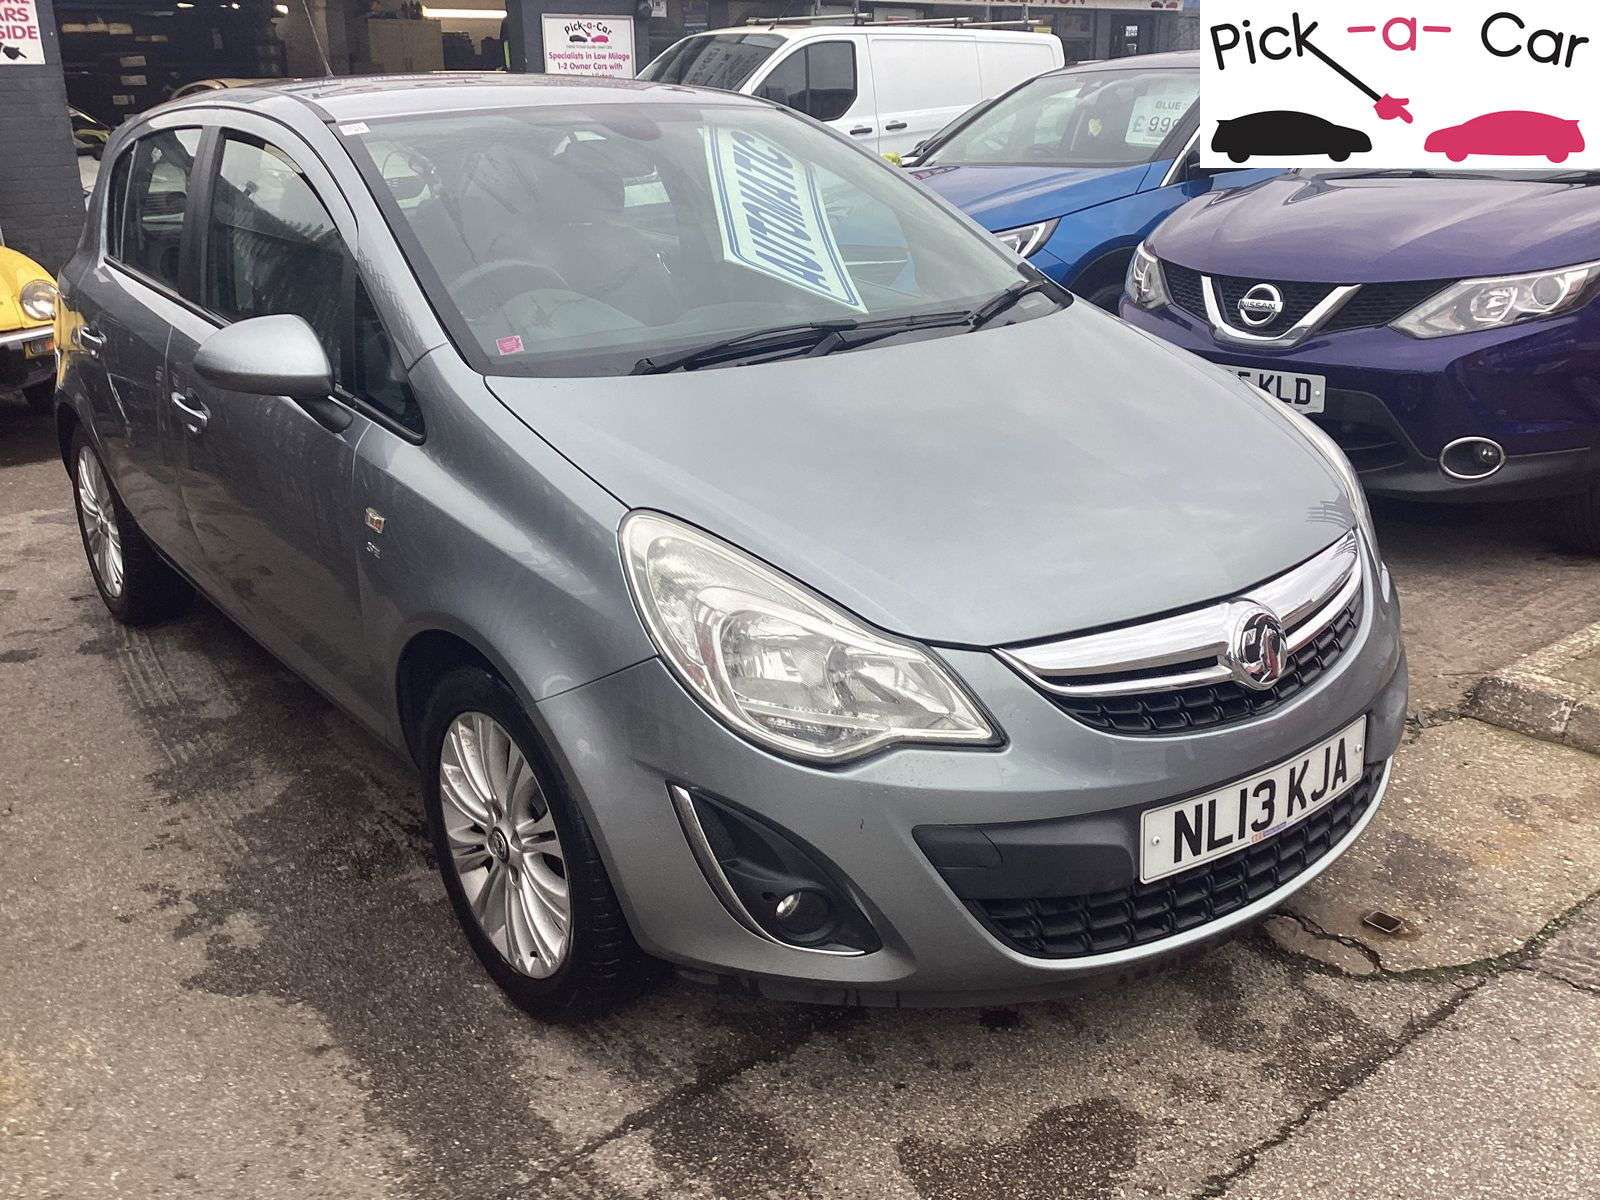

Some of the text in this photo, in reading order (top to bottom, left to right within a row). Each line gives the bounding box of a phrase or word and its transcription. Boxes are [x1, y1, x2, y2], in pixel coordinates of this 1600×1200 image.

[548, 51, 583, 61] Specialists
[585, 51, 592, 59] in
[594, 52, 607, 60] Low
[557, 62, 623, 70] 1-2 Owner Cars with
[731, 131, 832, 293] AUTOMATIC
[1240, 300, 1276, 310] NISSAN
[1259, 373, 1311, 405] KLD
[1173, 737, 1348, 864] NL13 KJA
